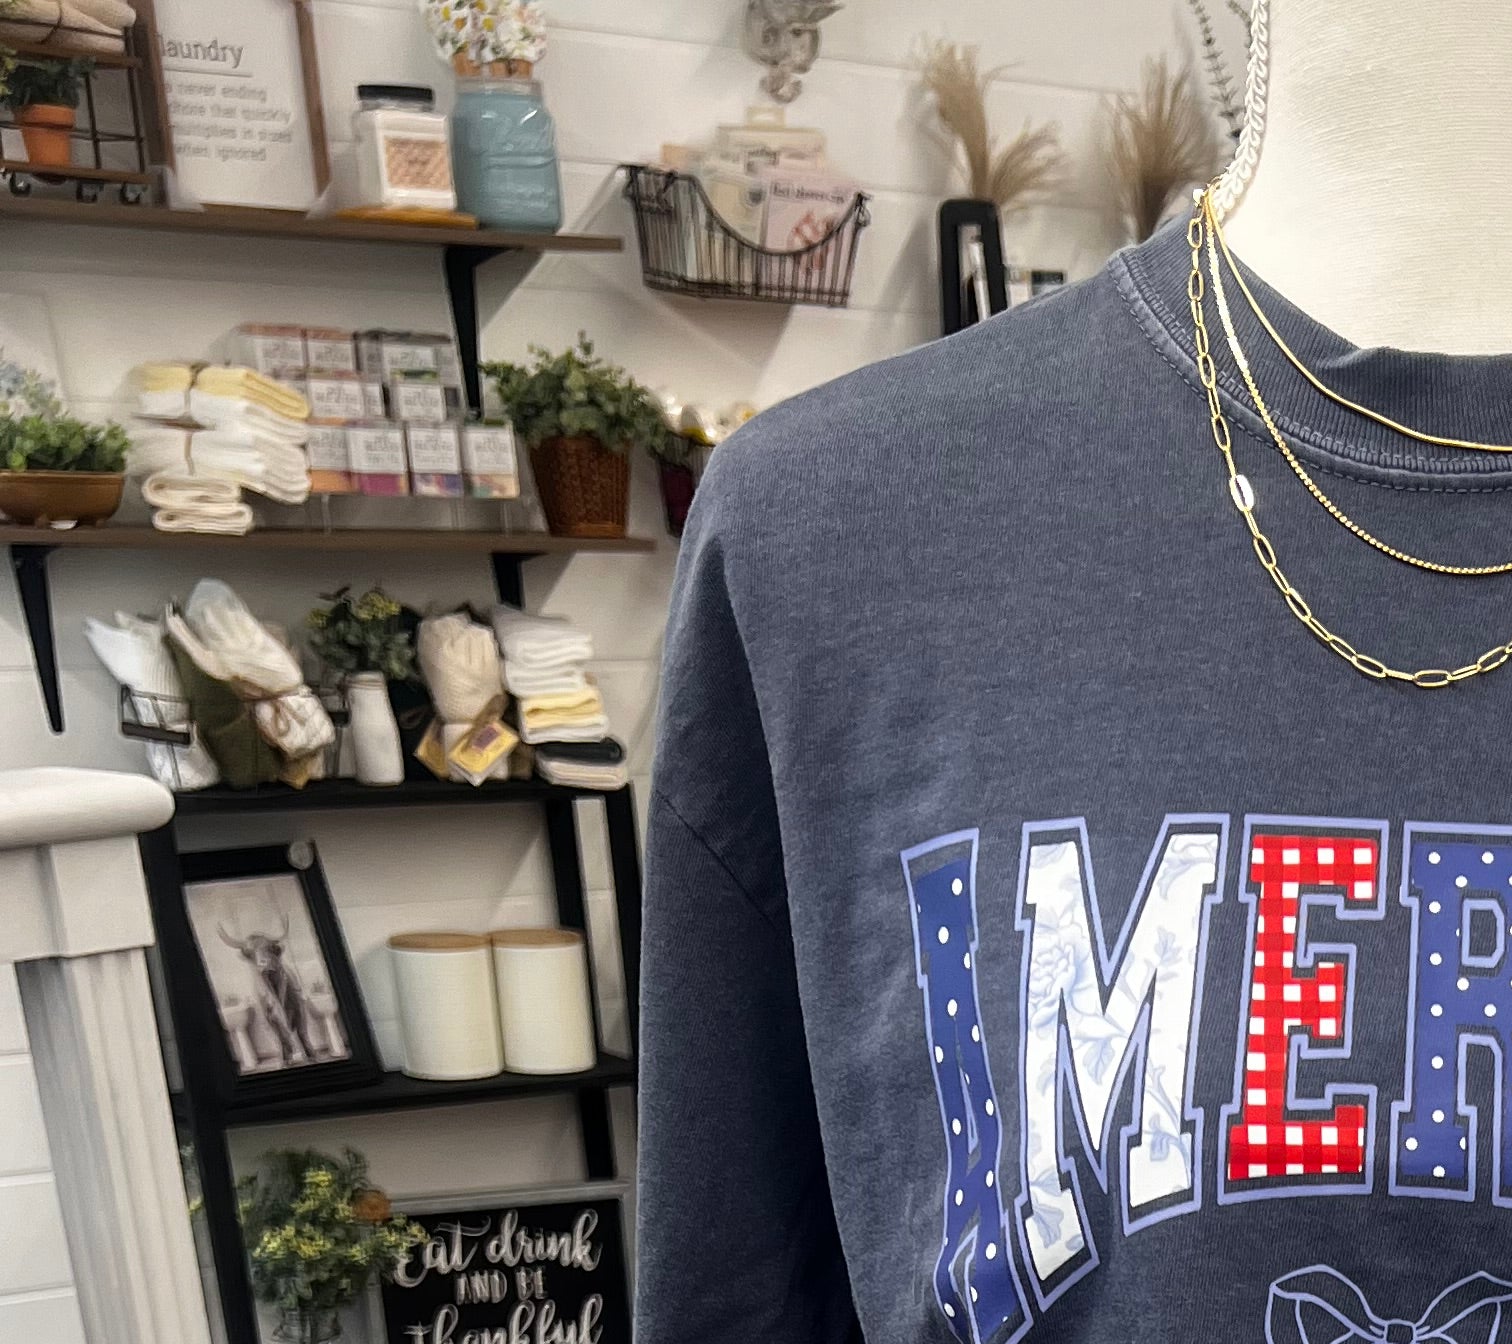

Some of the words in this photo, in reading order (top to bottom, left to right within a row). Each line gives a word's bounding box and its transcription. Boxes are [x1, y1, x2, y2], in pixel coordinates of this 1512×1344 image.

[485, 1208, 602, 1272] drink
[456, 1269, 508, 1305] AND
[514, 1265, 547, 1300] BE
